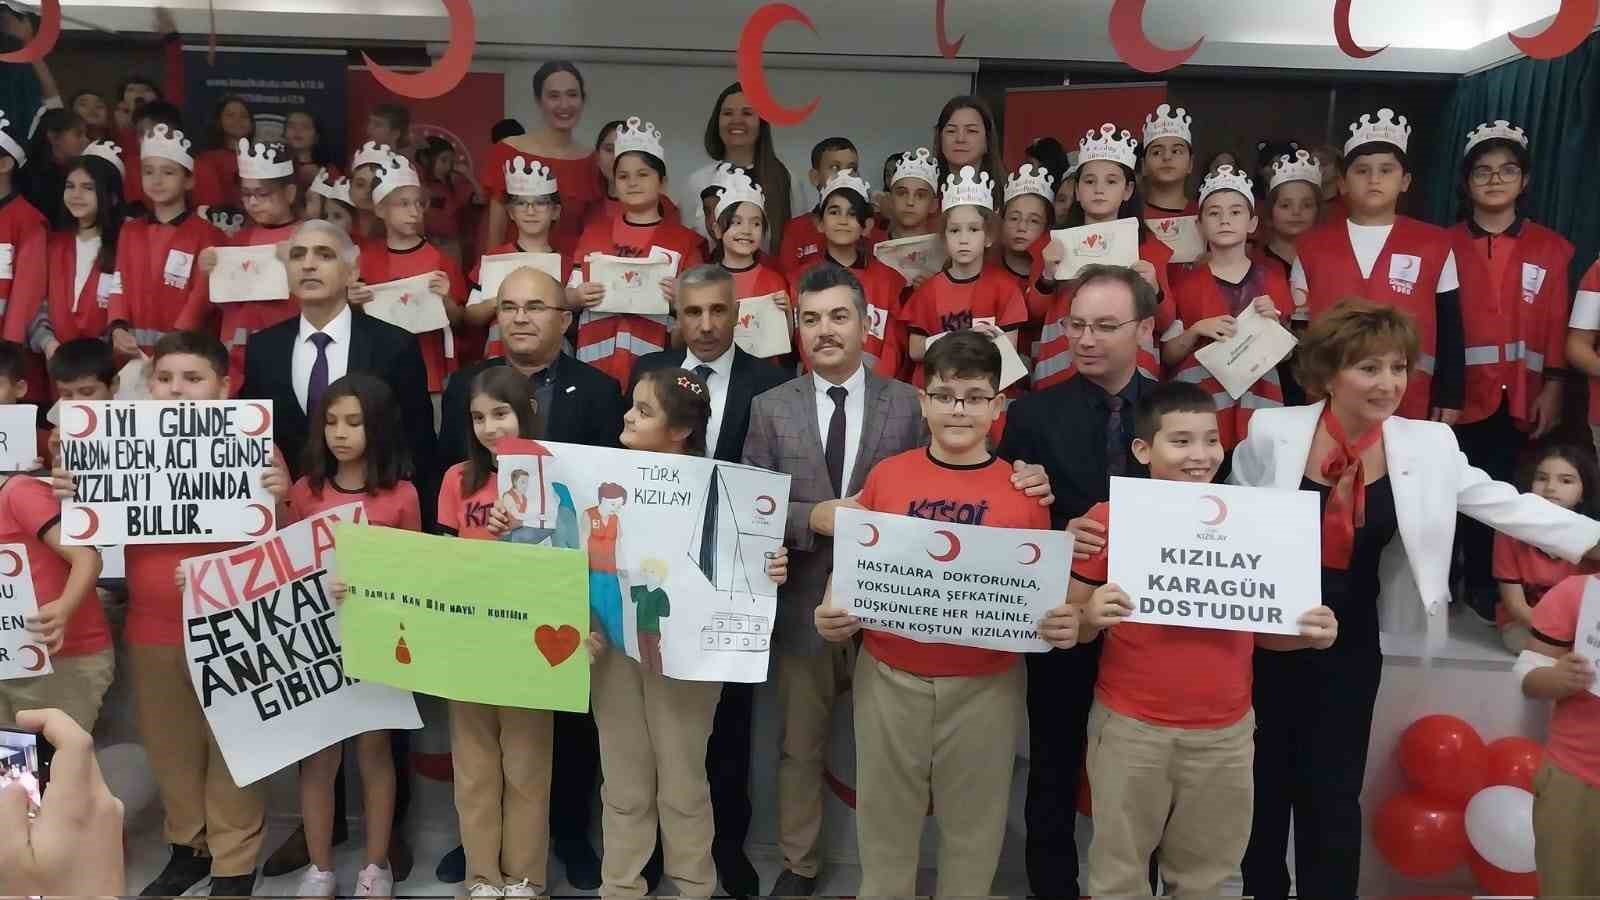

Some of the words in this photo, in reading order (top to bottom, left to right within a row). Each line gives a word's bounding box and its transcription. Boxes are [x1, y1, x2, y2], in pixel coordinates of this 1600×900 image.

[105, 403, 137, 437] İYİ
[159, 402, 237, 438] GÜNDE
[61, 439, 111, 472] YARDIM
[115, 438, 162, 473] EDEN,
[165, 438, 198, 469] ACI
[210, 437, 274, 468] GÜNDE
[72, 472, 151, 503] KIZILAY'I
[167, 471, 251, 501] YANINDA
[637, 465, 680, 484] TÜRK
[634, 487, 691, 506] KIZILAYI
[127, 503, 213, 536] BULUR.
[464, 501, 494, 528] KT
[1160, 547, 1263, 570] KIZILAY
[857, 559, 933, 580] HASTALARA
[943, 571, 1041, 592] DOKTORUNLA,
[1148, 574, 1276, 600] KARAGÜN
[857, 579, 941, 599] YOKSULLARA
[946, 590, 1028, 607] ŞEFKATİNLE,
[854, 597, 938, 617] DÜŞKÜNLERE
[942, 609, 968, 619] HER
[1139, 597, 1284, 624] DOSTUDUR
[880, 619, 905, 630] SEN
[909, 621, 962, 636] KOŞTUN
[971, 626, 1041, 640] KIZILAYIM.
